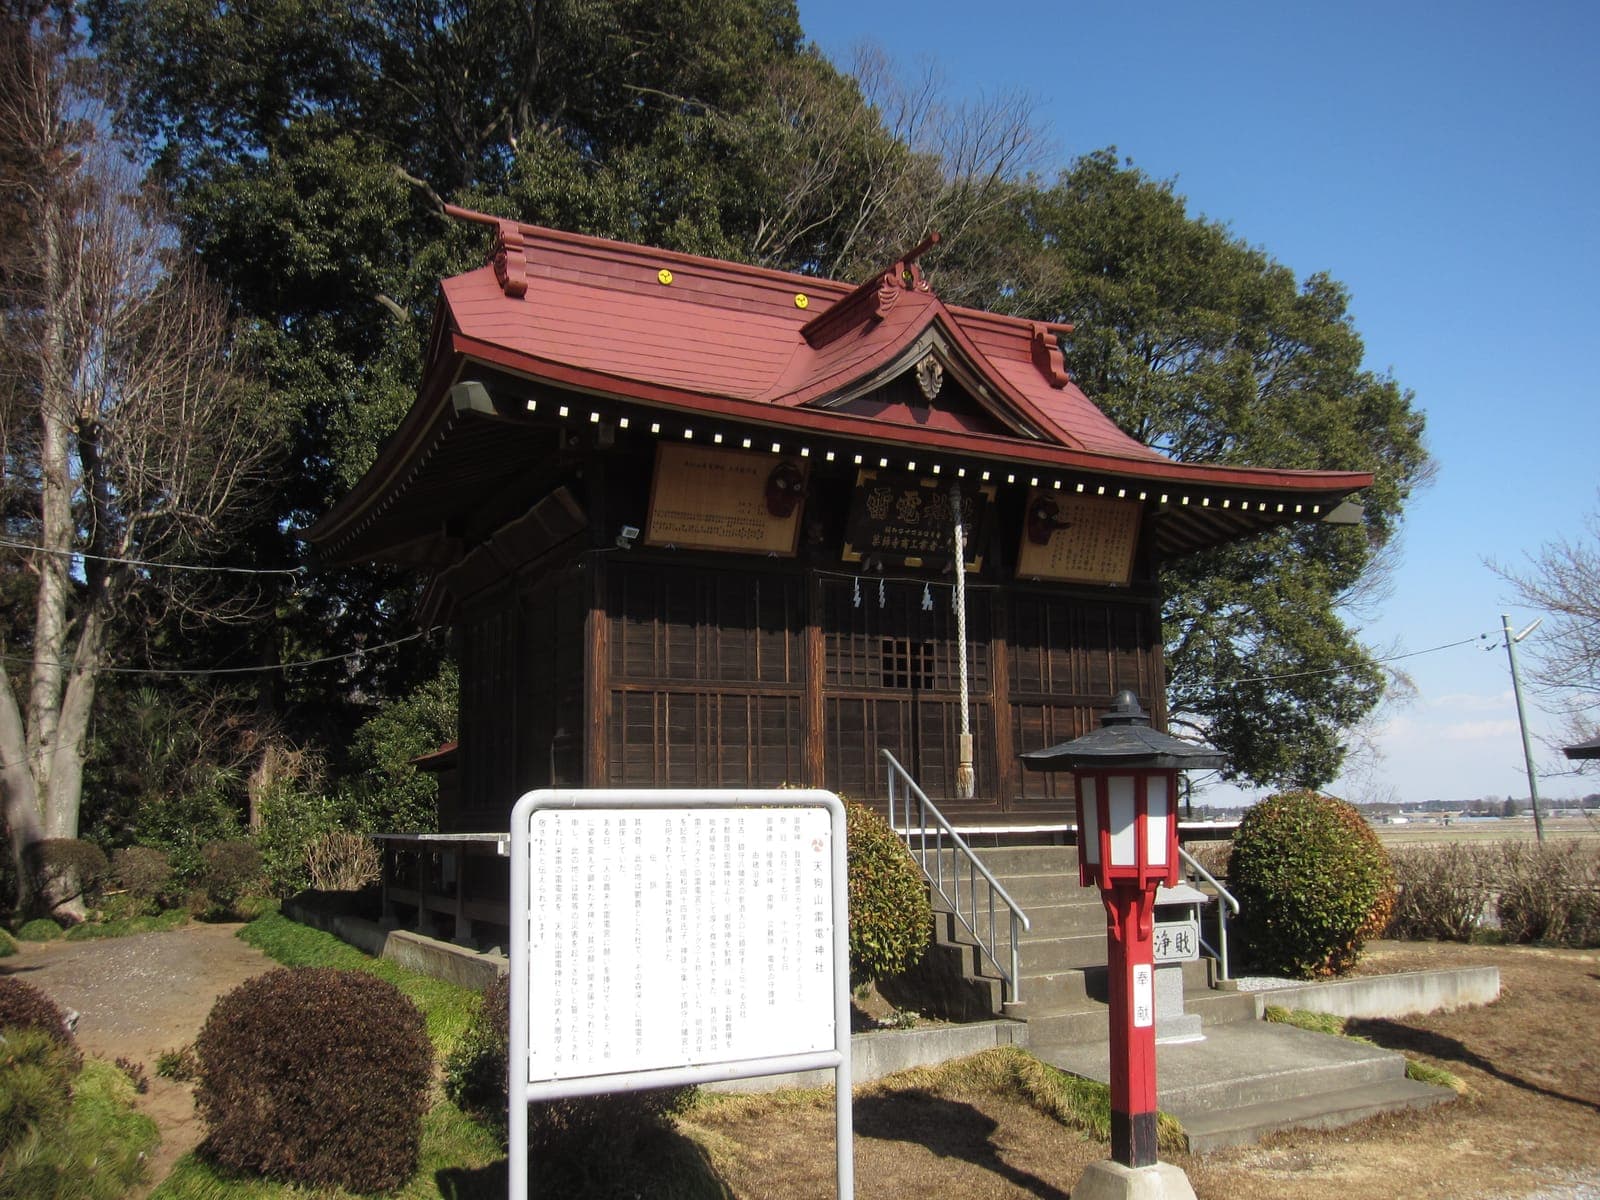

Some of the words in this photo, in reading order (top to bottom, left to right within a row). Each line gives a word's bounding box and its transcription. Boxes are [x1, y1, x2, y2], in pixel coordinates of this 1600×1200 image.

[813, 860, 825, 973] 天狗山雷電神社
